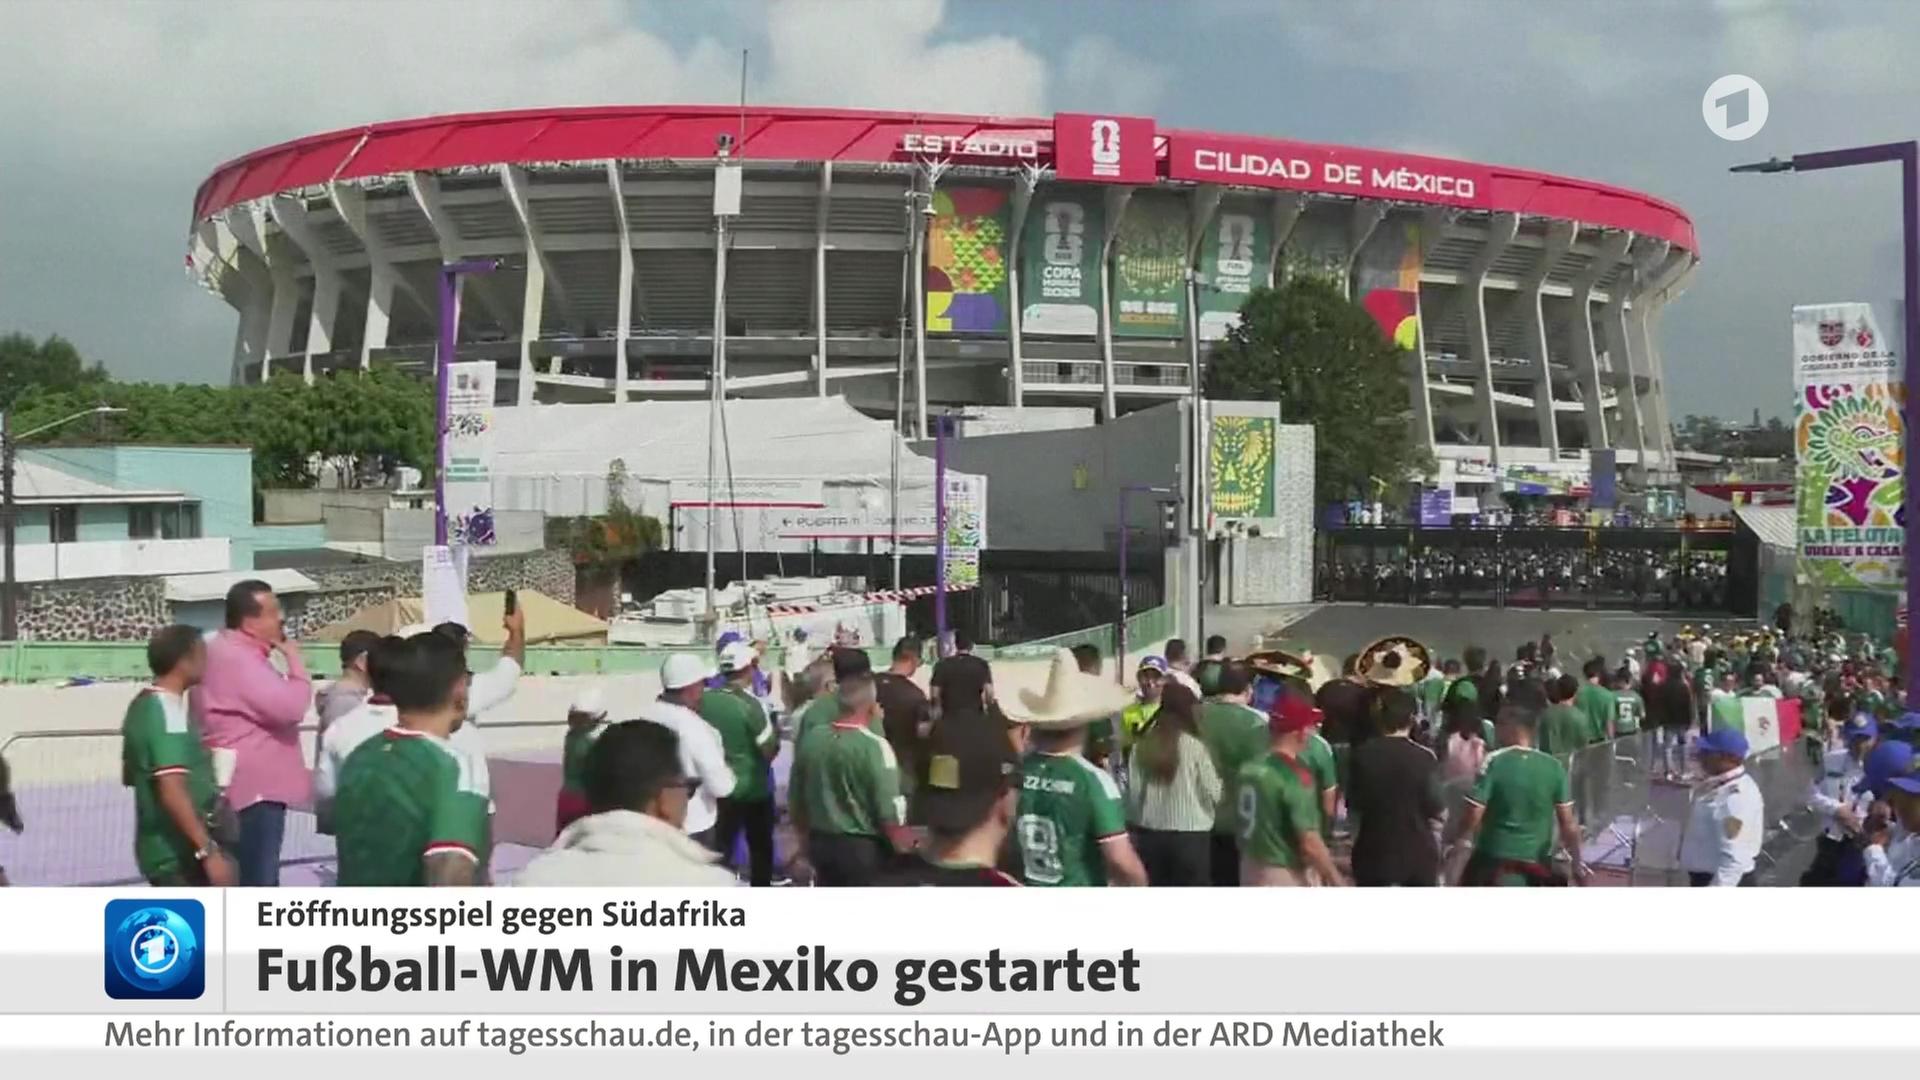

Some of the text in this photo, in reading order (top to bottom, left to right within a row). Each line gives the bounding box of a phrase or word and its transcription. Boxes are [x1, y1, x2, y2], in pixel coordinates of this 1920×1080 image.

[903, 133, 1038, 158] ESTADIO
[1194, 150, 1476, 198] CIUDAD DE MÉXICO
[1043, 266, 1082, 279] COPA
[1800, 352, 1858, 363] GOBIERNO
[1862, 350, 1877, 360] DE
[1803, 528, 1904, 544] LA PELOTA
[1867, 545, 1904, 557] CASA
